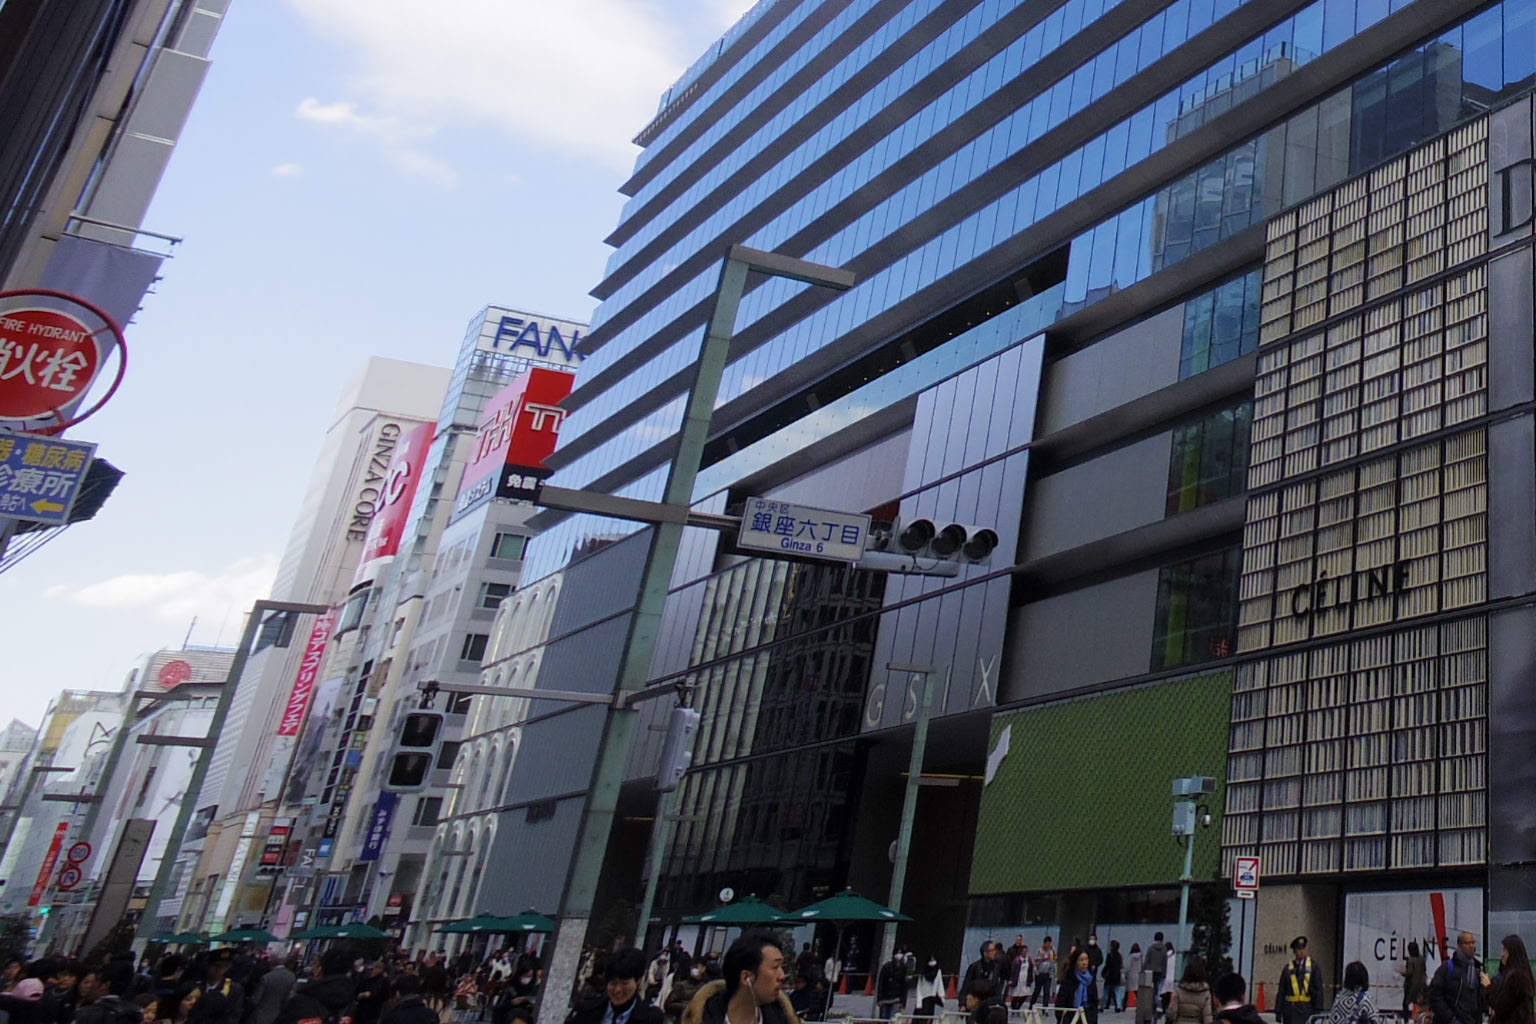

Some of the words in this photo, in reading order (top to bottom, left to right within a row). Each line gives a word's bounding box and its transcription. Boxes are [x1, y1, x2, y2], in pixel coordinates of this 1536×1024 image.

[28, 323, 88, 343] HYDRANT
[493, 316, 588, 362] FAN
[365, 423, 401, 483] GINZA
[345, 487, 379, 542] CORE
[754, 500, 791, 515] 中央区
[750, 511, 860, 545] 銀座六丁目
[780, 537, 812, 553] Ginza
[815, 541, 824, 553] 6
[1291, 558, 1412, 620] CÉLINE
[1374, 930, 1450, 961] CÉLNE
